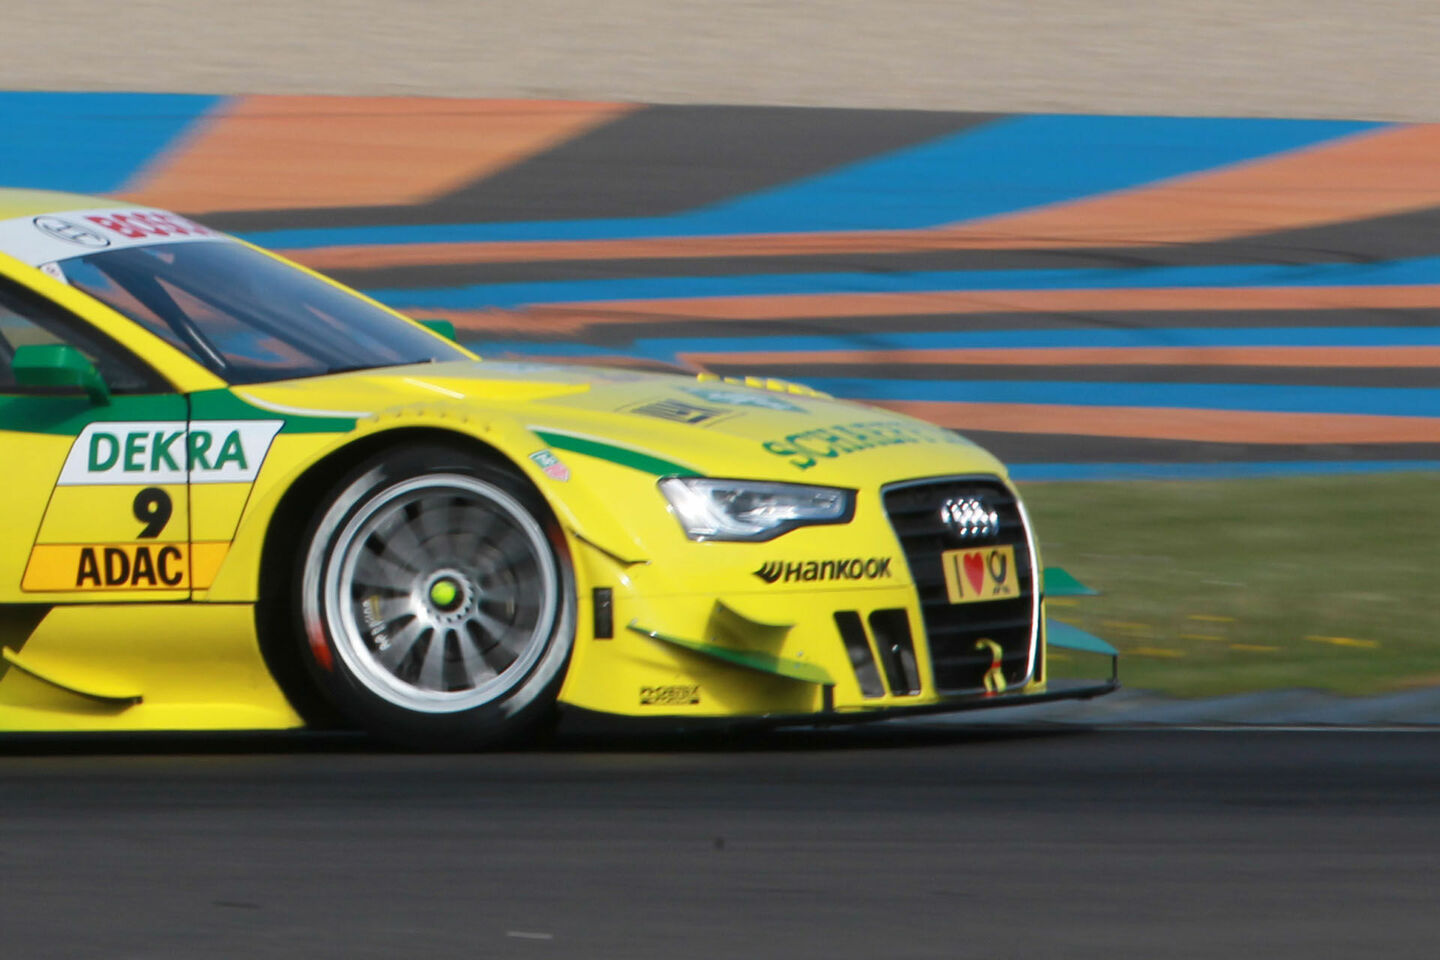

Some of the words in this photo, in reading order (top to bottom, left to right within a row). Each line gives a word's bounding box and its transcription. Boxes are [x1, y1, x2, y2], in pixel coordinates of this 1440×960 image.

[87, 429, 248, 473] DEKRA
[132, 486, 173, 540] 9
[75, 546, 184, 587] ADAC
